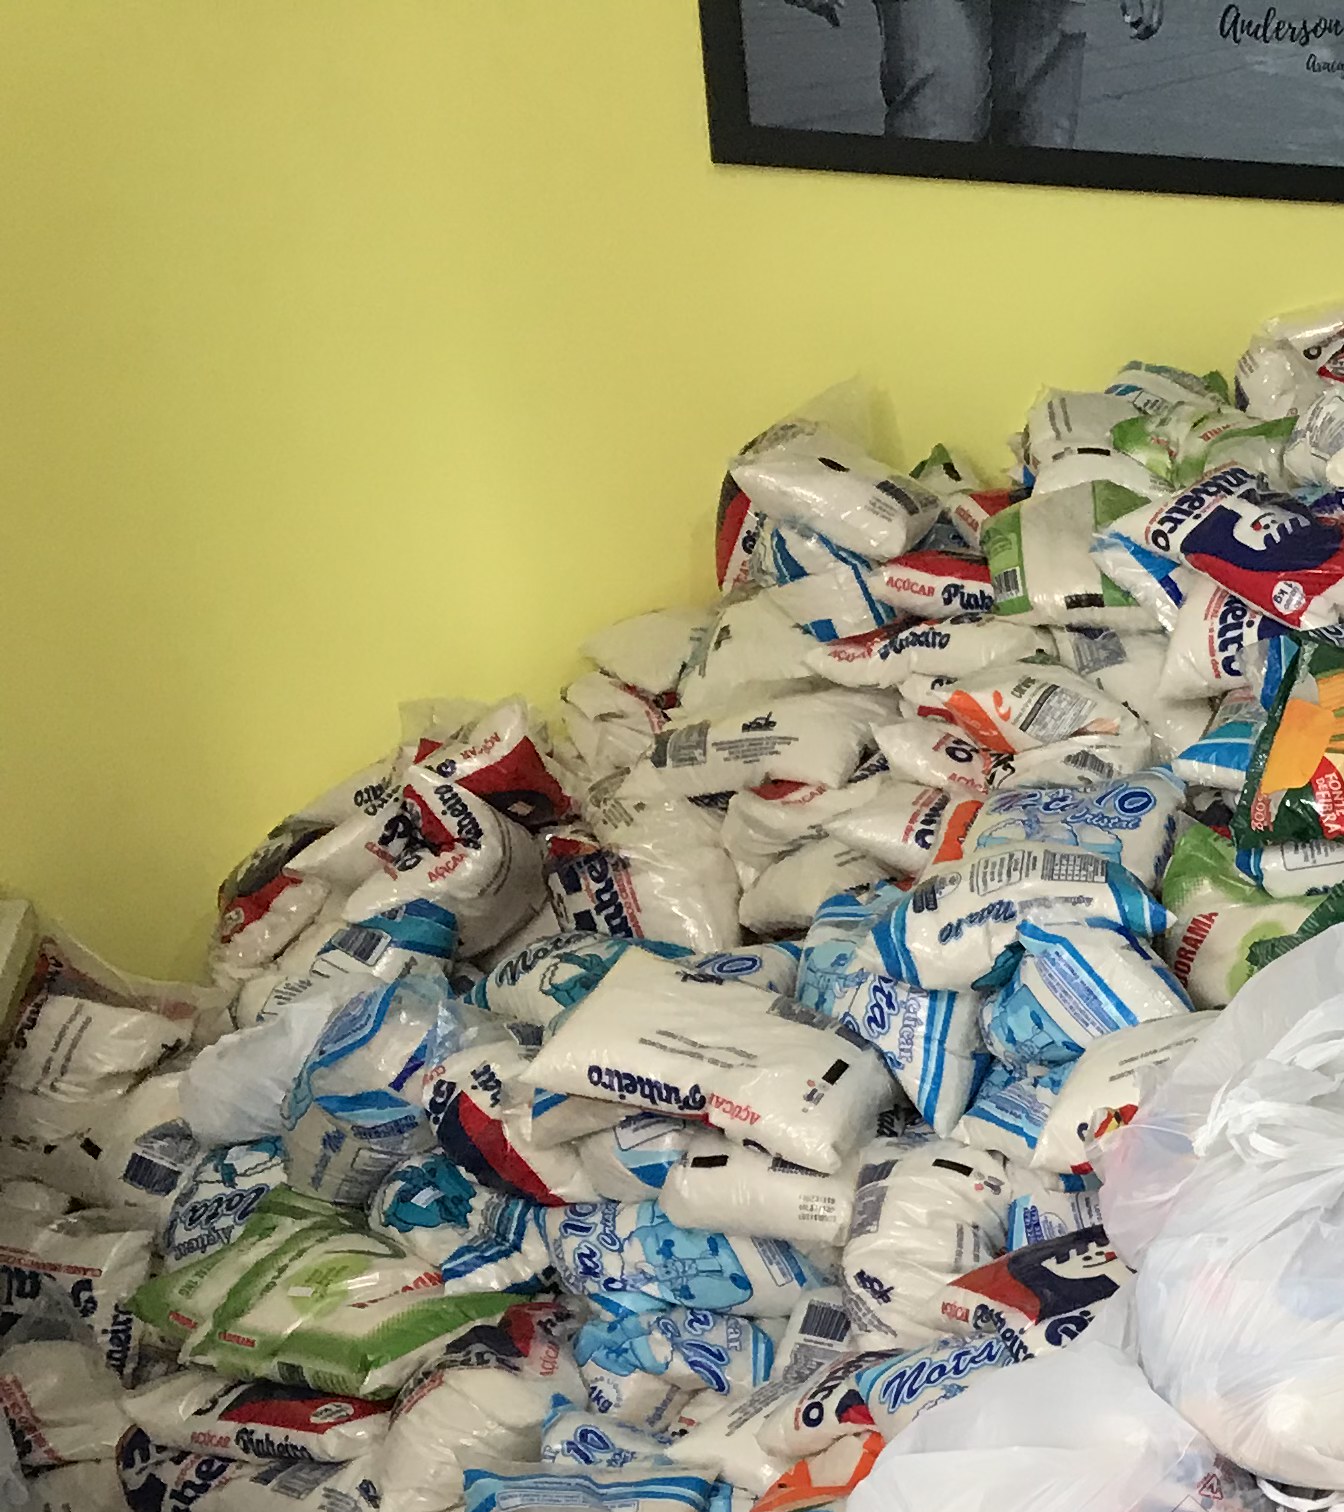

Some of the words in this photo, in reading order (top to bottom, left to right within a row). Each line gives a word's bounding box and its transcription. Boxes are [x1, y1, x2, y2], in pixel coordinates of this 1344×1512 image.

[1219, 5, 1343, 46] Anderson
[886, 576, 935, 598] AÇÚCAR
[941, 582, 995, 613] Pinh
[1066, 808, 1145, 831] Cristal
[1322, 790, 1338, 834] FIBRA
[937, 918, 965, 946] 10
[588, 1064, 709, 1112] Pinheiro
[190, 1430, 231, 1449] AÇÚCAR
[565, 1424, 613, 1464] 10
